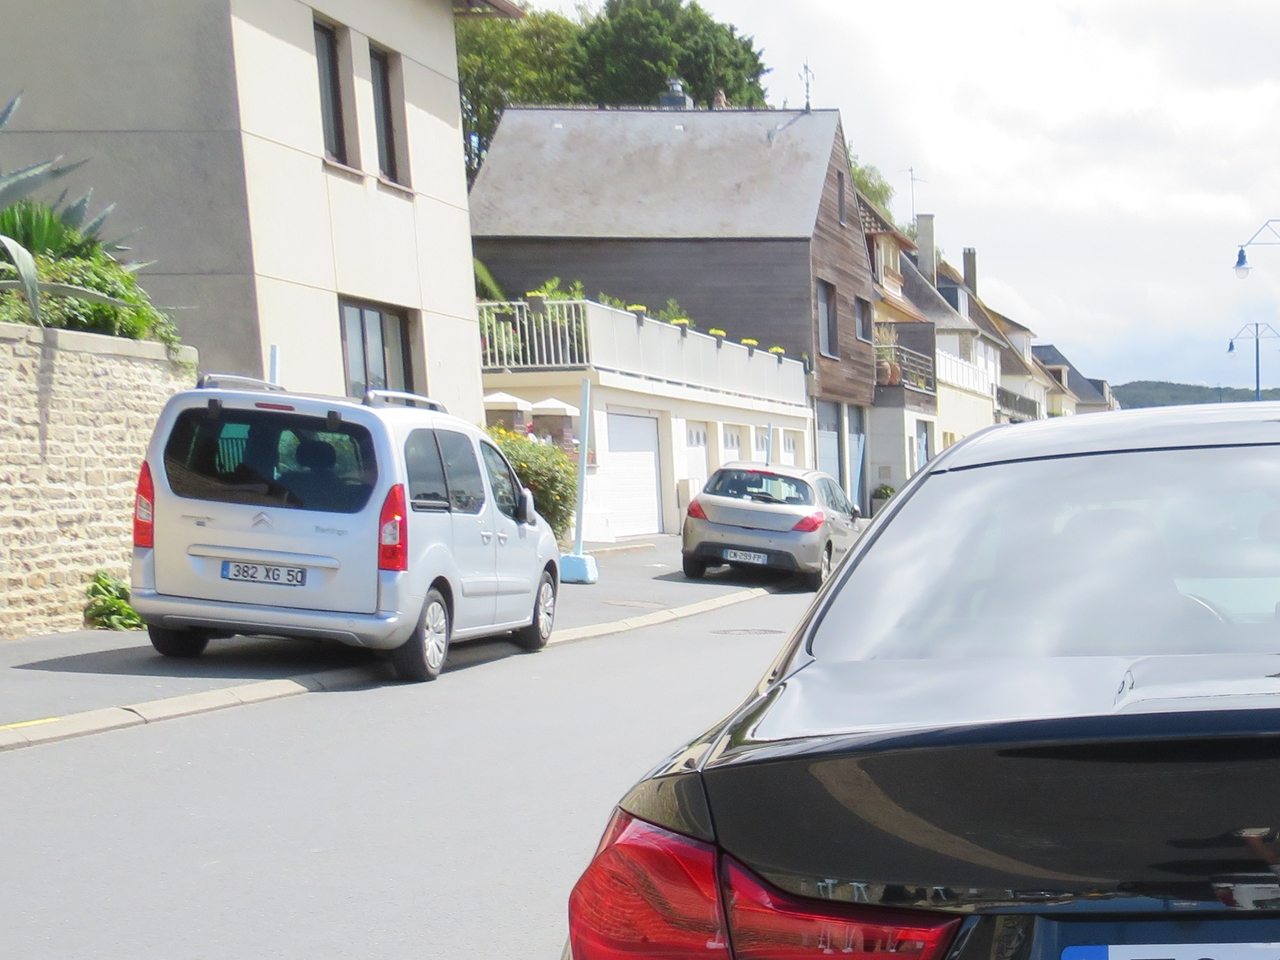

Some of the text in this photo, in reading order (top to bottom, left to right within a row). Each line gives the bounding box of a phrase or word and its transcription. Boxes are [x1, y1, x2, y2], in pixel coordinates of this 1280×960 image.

[233, 564, 258, 579] 382
[264, 567, 281, 581] XG
[286, 570, 303, 583] 50
